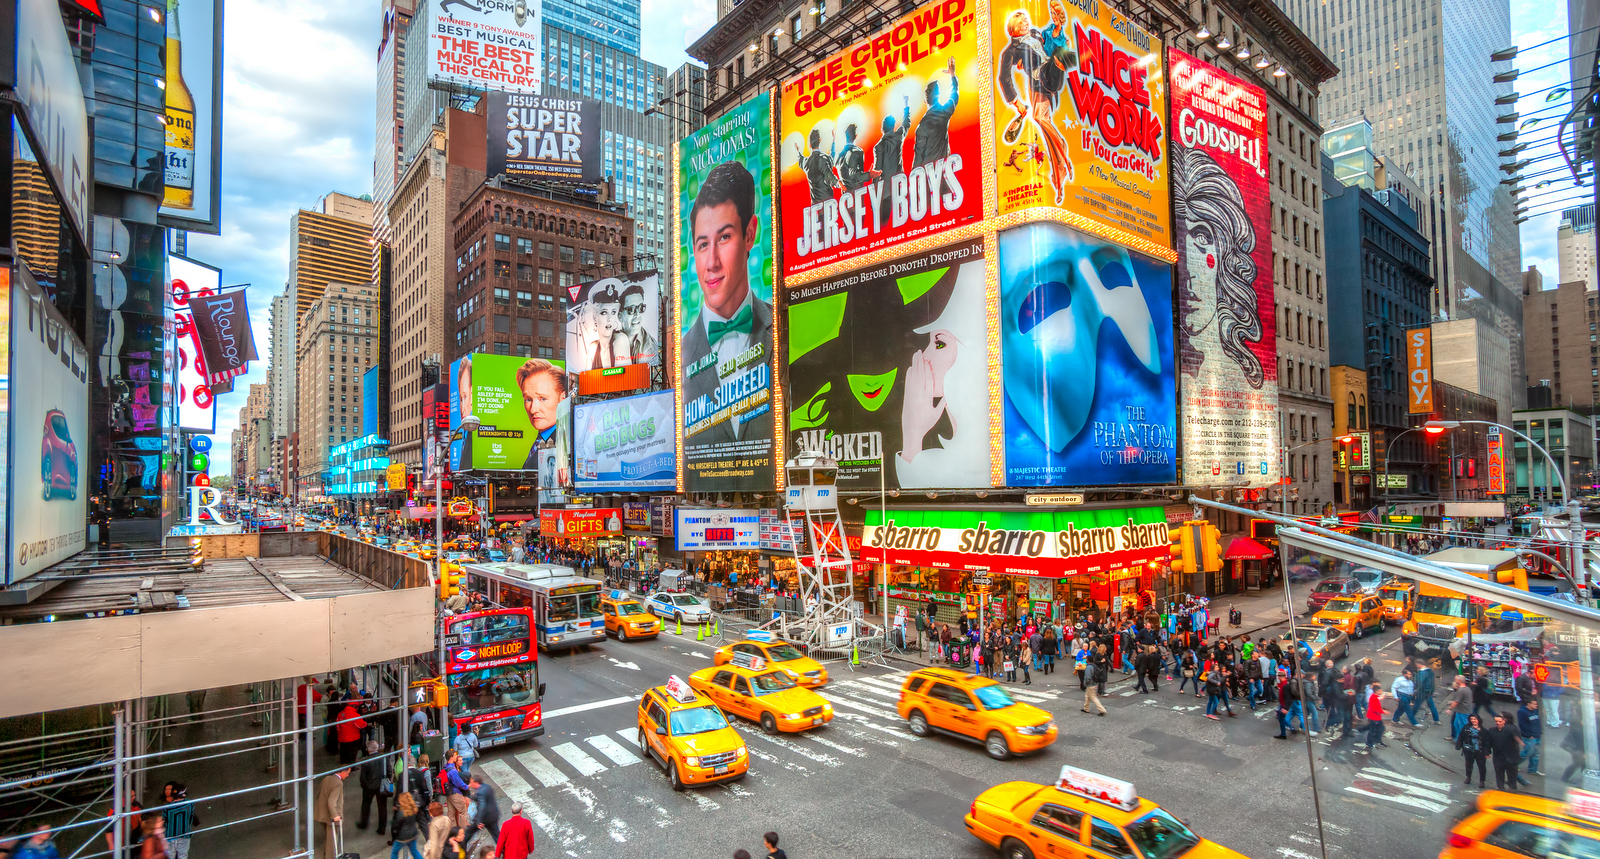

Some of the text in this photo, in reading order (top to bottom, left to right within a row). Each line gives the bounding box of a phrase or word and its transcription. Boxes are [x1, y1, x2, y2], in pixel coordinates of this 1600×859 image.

[438, 16, 471, 28] WINNER
[480, 24, 501, 33] TONY
[503, 28, 535, 40] AWARDS
[438, 24, 535, 50] BEST MUSICAL
[850, 0, 966, 68] CROWD
[438, 50, 534, 76] MUSICAL OF
[484, 43, 534, 65] BEST
[1074, 21, 1150, 107] NICE
[438, 62, 469, 75] THIS
[794, 68, 867, 117] GOES
[854, 90, 868, 102] New
[869, 82, 883, 94] York
[884, 73, 904, 86] Times
[506, 95, 582, 112] JESUS CHRIST
[1068, 70, 1162, 162] WORK
[506, 108, 582, 135] SUPER
[692, 110, 750, 150] Now starring
[506, 130, 582, 162] STAR
[690, 127, 756, 175] NICK JONAS!
[1082, 130, 1154, 180] If You Can Get It
[1180, 108, 1266, 178] GODSPELL
[506, 168, 582, 178] SuperstarOnBroadway.com
[1088, 164, 1094, 174] A
[1096, 166, 1109, 182] New
[1110, 172, 1132, 192] Musical
[1132, 183, 1152, 204] Comedy
[1006, 190, 1039, 204] THEATRE
[1008, 182, 1044, 197] IMPERIAL
[1022, 198, 1036, 206] 45th
[796, 154, 964, 257] JERSEY BOYS
[794, 218, 956, 272] August Wilson Theatre, 245 West 52nd Street
[801, 287, 821, 298] MUCH
[822, 278, 858, 292] HAPPENED
[860, 270, 888, 284] BEFORE
[889, 256, 928, 275] DOROTHY
[930, 248, 970, 266] DROPPED
[684, 394, 711, 428] HOW
[706, 401, 714, 414] TO
[714, 362, 770, 411] SUCCEED
[603, 404, 630, 430] BAN
[1126, 406, 1146, 421] THE
[1187, 415, 1233, 427] Telecharge.com
[594, 416, 656, 453] BED BUGS
[1093, 421, 1174, 448] PHANTOM
[616, 446, 636, 458] occupying
[636, 444, 646, 452] your
[646, 438, 666, 448] mattress
[1100, 450, 1169, 465] OF THE OPERA
[1488, 441, 1501, 490] PARK
[186, 485, 238, 526] R
[628, 509, 648, 520] GIFTS
[541, 520, 556, 532] GIFTS
[567, 520, 602, 532] GIFTS
[706, 528, 734, 540] GIFTS
[871, 518, 1168, 558] sbarro sbarro sbarro sbarro
[835, 626, 848, 636] NYPD
[479, 642, 522, 658] NIGHT LOOP
[490, 658, 518, 667] Sightseeing
